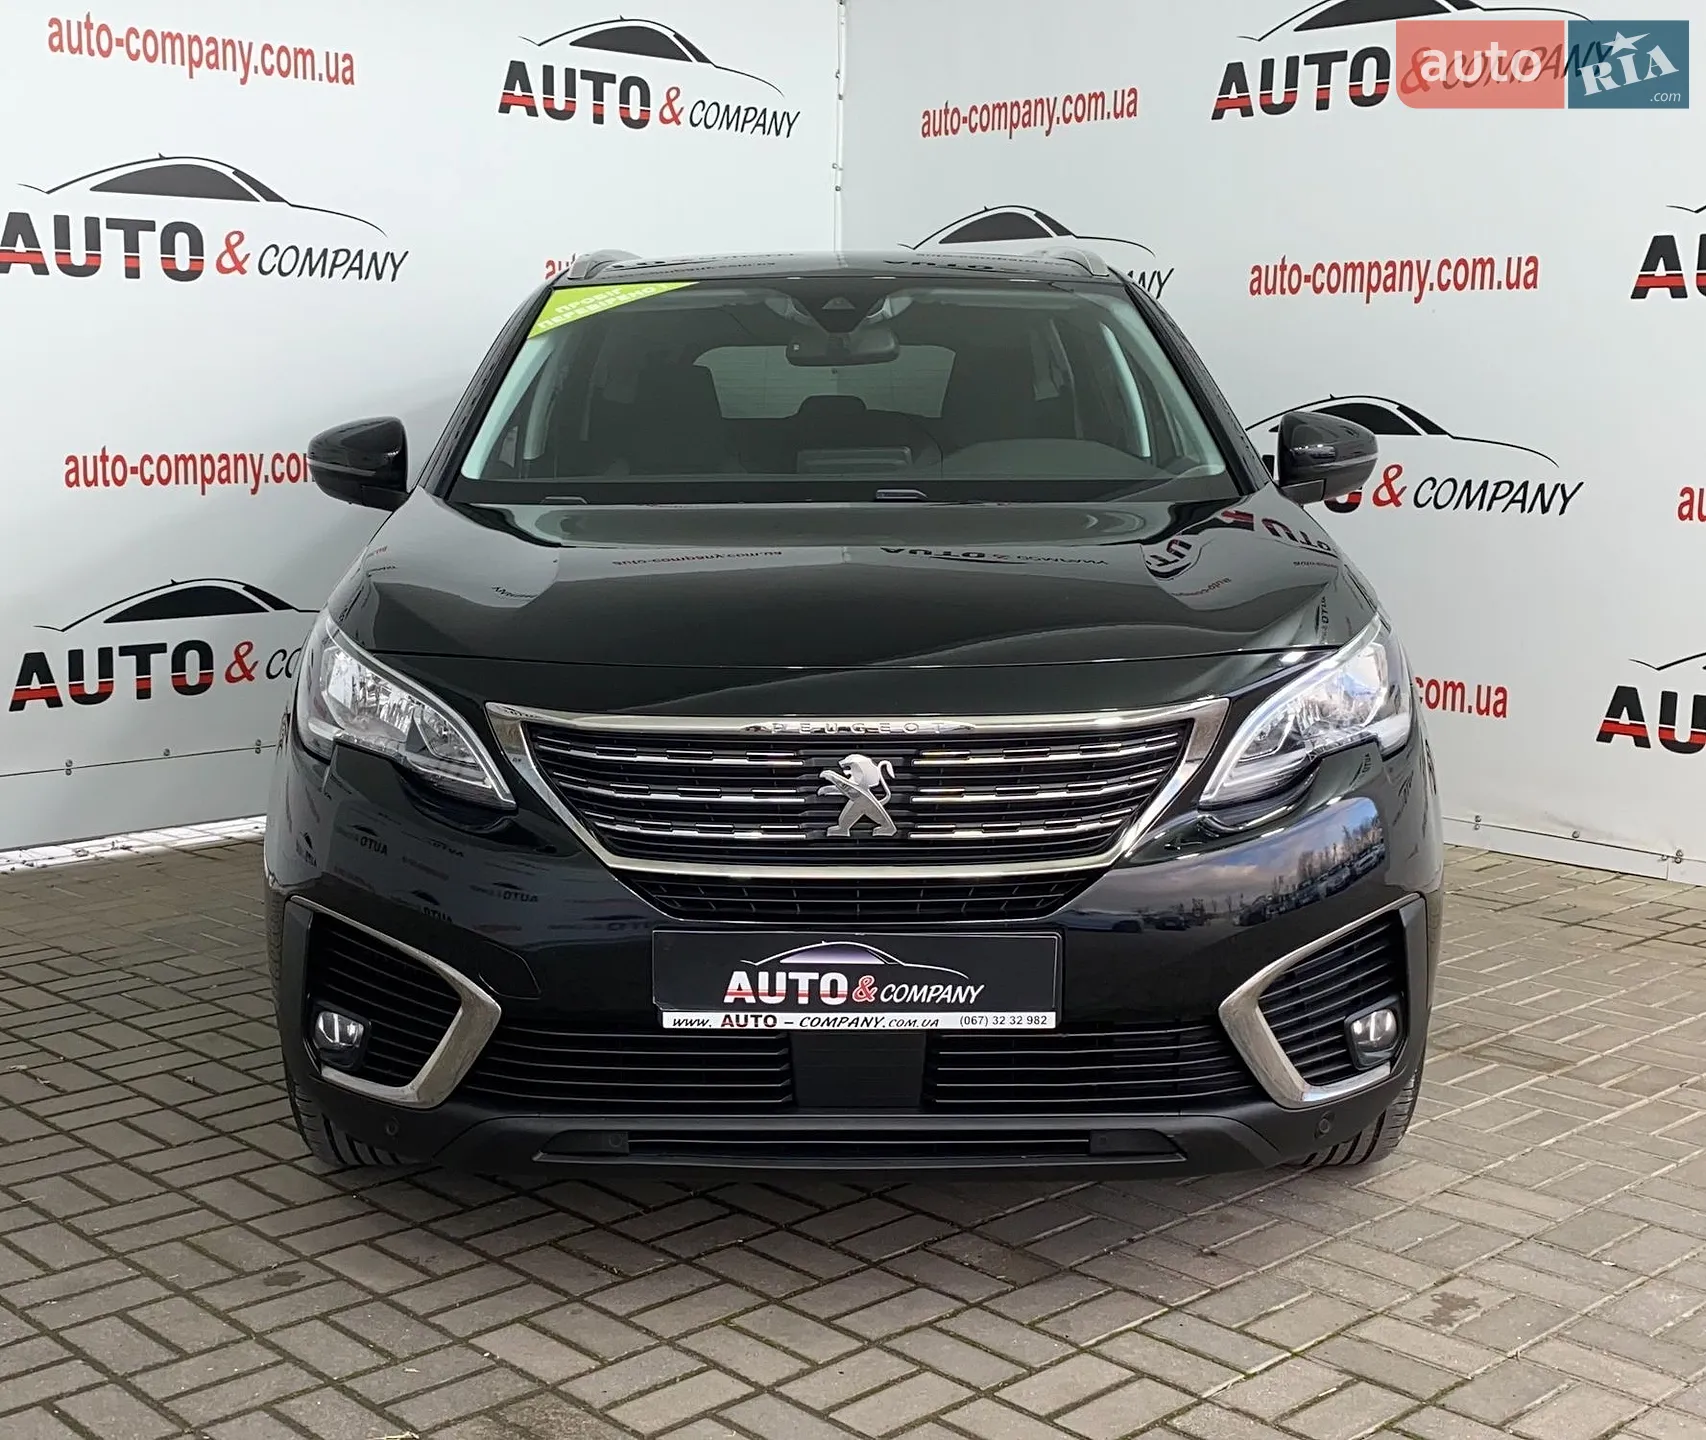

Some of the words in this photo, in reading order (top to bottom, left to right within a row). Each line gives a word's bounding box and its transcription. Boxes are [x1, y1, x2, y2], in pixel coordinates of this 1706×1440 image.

[48, 13, 354, 85] auto-company.com.ua
[498, 60, 651, 129] AUTO
[658, 86, 684, 126] &
[689, 100, 800, 138] COMPANY
[1211, 46, 1391, 121] AUTO
[922, 86, 1138, 139] auto-company.com.ua
[0, 211, 205, 282] AUTO
[215, 230, 252, 275] &
[257, 243, 410, 283] COMPANY
[1249, 254, 1539, 304] auto-company.com.ua
[1372, 463, 1408, 508] &
[1413, 477, 1584, 516] COMPANY
[8, 639, 214, 713] AUTO
[224, 640, 259, 684] &
[771, 722, 945, 735] PEUGEOT
[724, 971, 848, 1005] AUTO
[852, 975, 879, 1002] &
[880, 984, 985, 1004] COMPANY
[720, 1014, 778, 1028] AUTO
[959, 1015, 989, 1028] (067)
[992, 1015, 1006, 1026] 32
[1009, 1015, 1024, 1026] 32
[1026, 1015, 1048, 1026] 982
